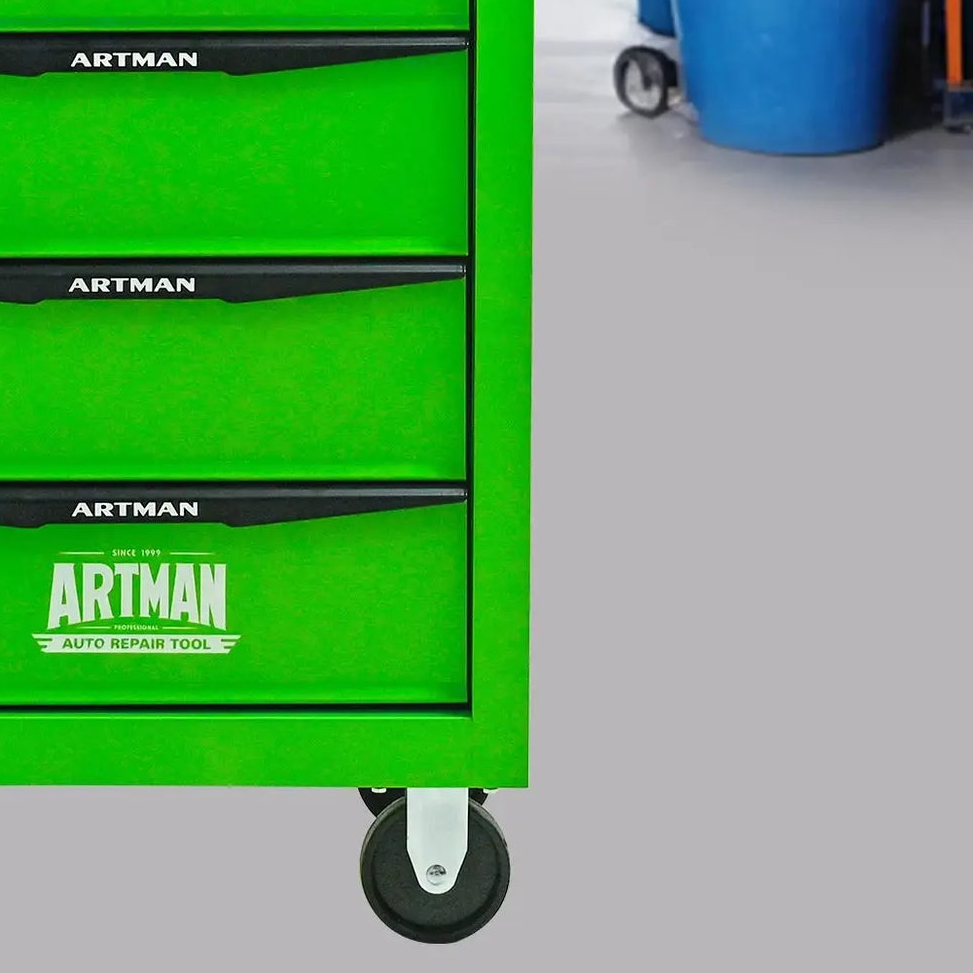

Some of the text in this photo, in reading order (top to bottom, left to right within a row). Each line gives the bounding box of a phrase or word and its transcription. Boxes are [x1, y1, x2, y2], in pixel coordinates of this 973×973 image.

[70, 52, 198, 67] ARTMAN
[68, 277, 196, 293] ARTMAN
[71, 501, 199, 517] ARTMAN
[112, 549, 161, 557] SINCE 1999
[46, 563, 227, 631] ARTMAN
[62, 638, 211, 650] AUTO REPAIR TOOL
